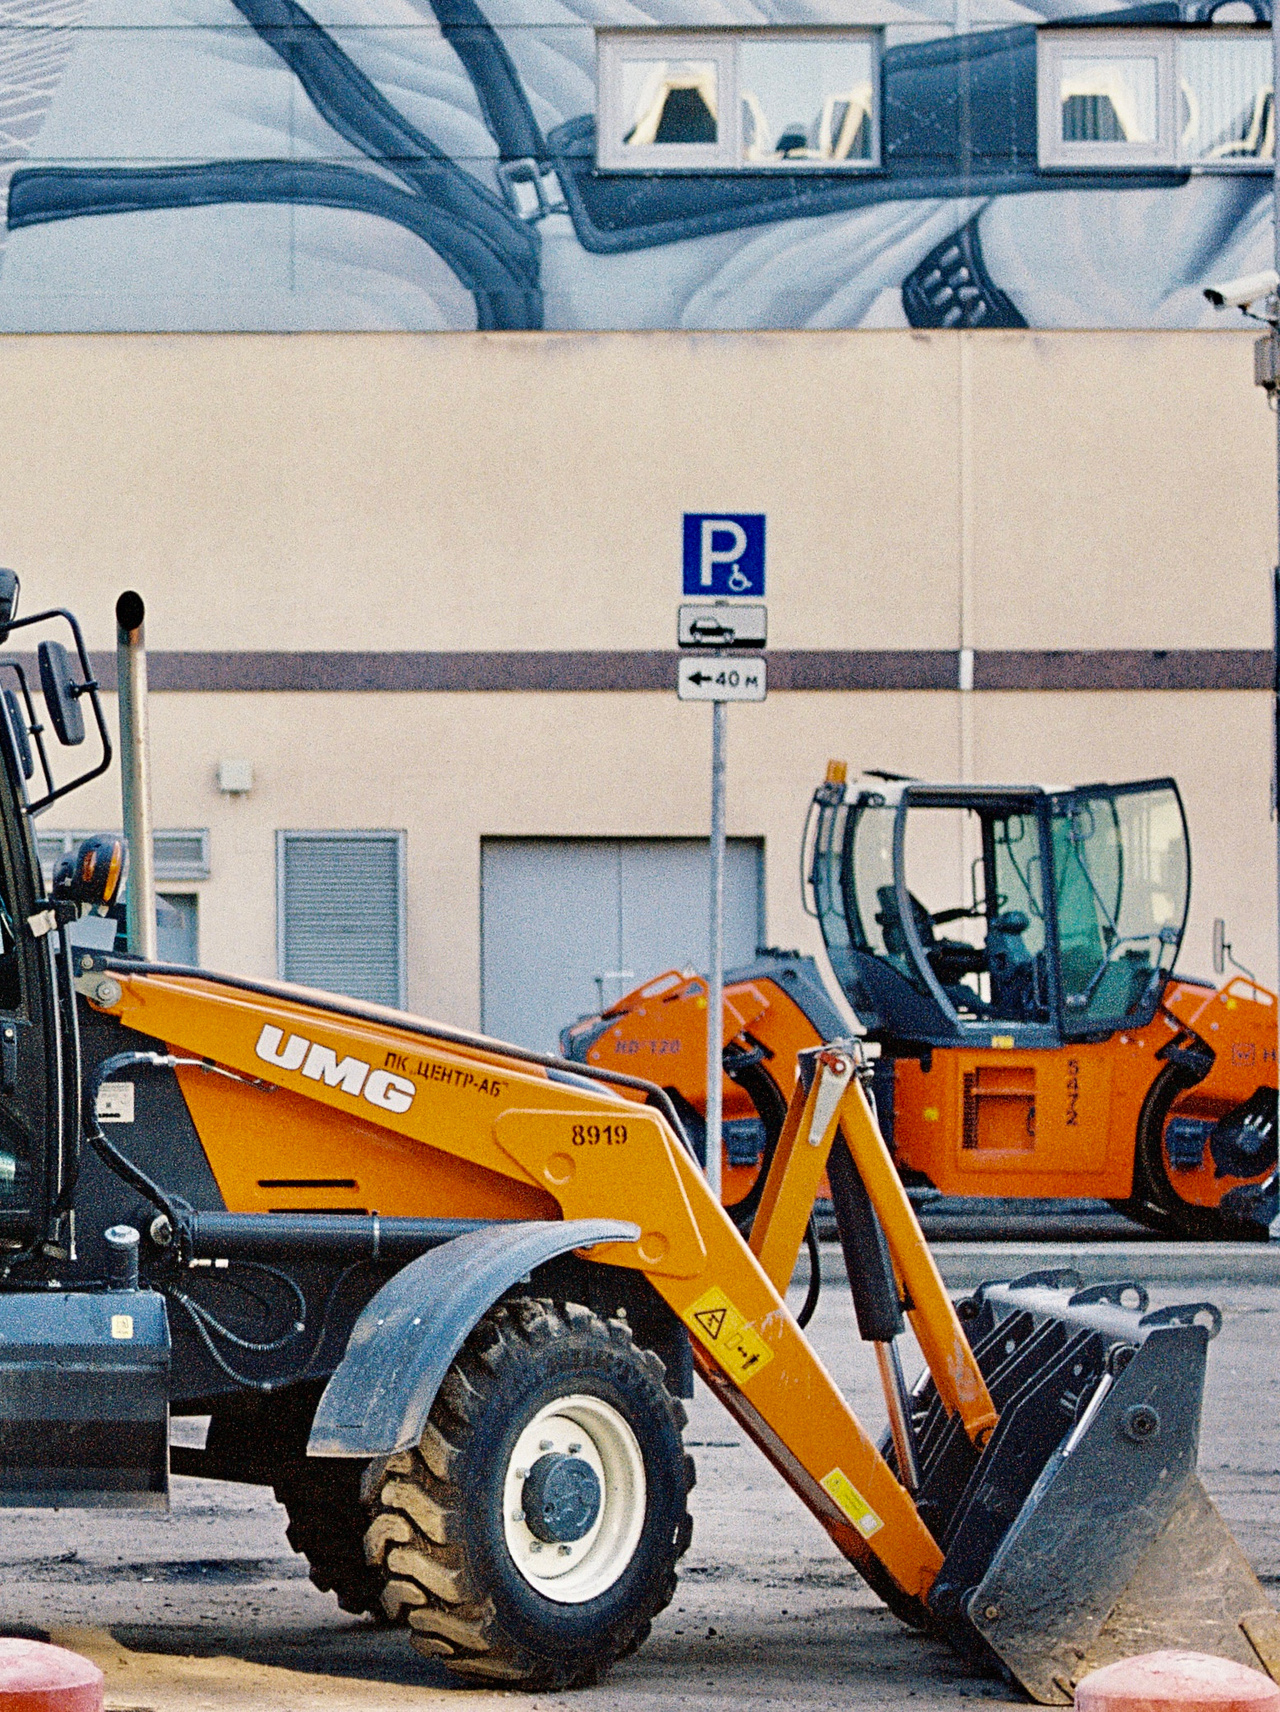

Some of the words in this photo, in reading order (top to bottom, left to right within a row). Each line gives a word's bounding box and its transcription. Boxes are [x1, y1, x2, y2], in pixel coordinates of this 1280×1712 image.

[700, 519, 748, 587] P
[715, 671, 740, 687] 40
[254, 1023, 417, 1115] UMG
[384, 1051, 410, 1072] ПК
[1065, 1059, 1079, 1126] 5472
[571, 1125, 628, 1146] 8919
